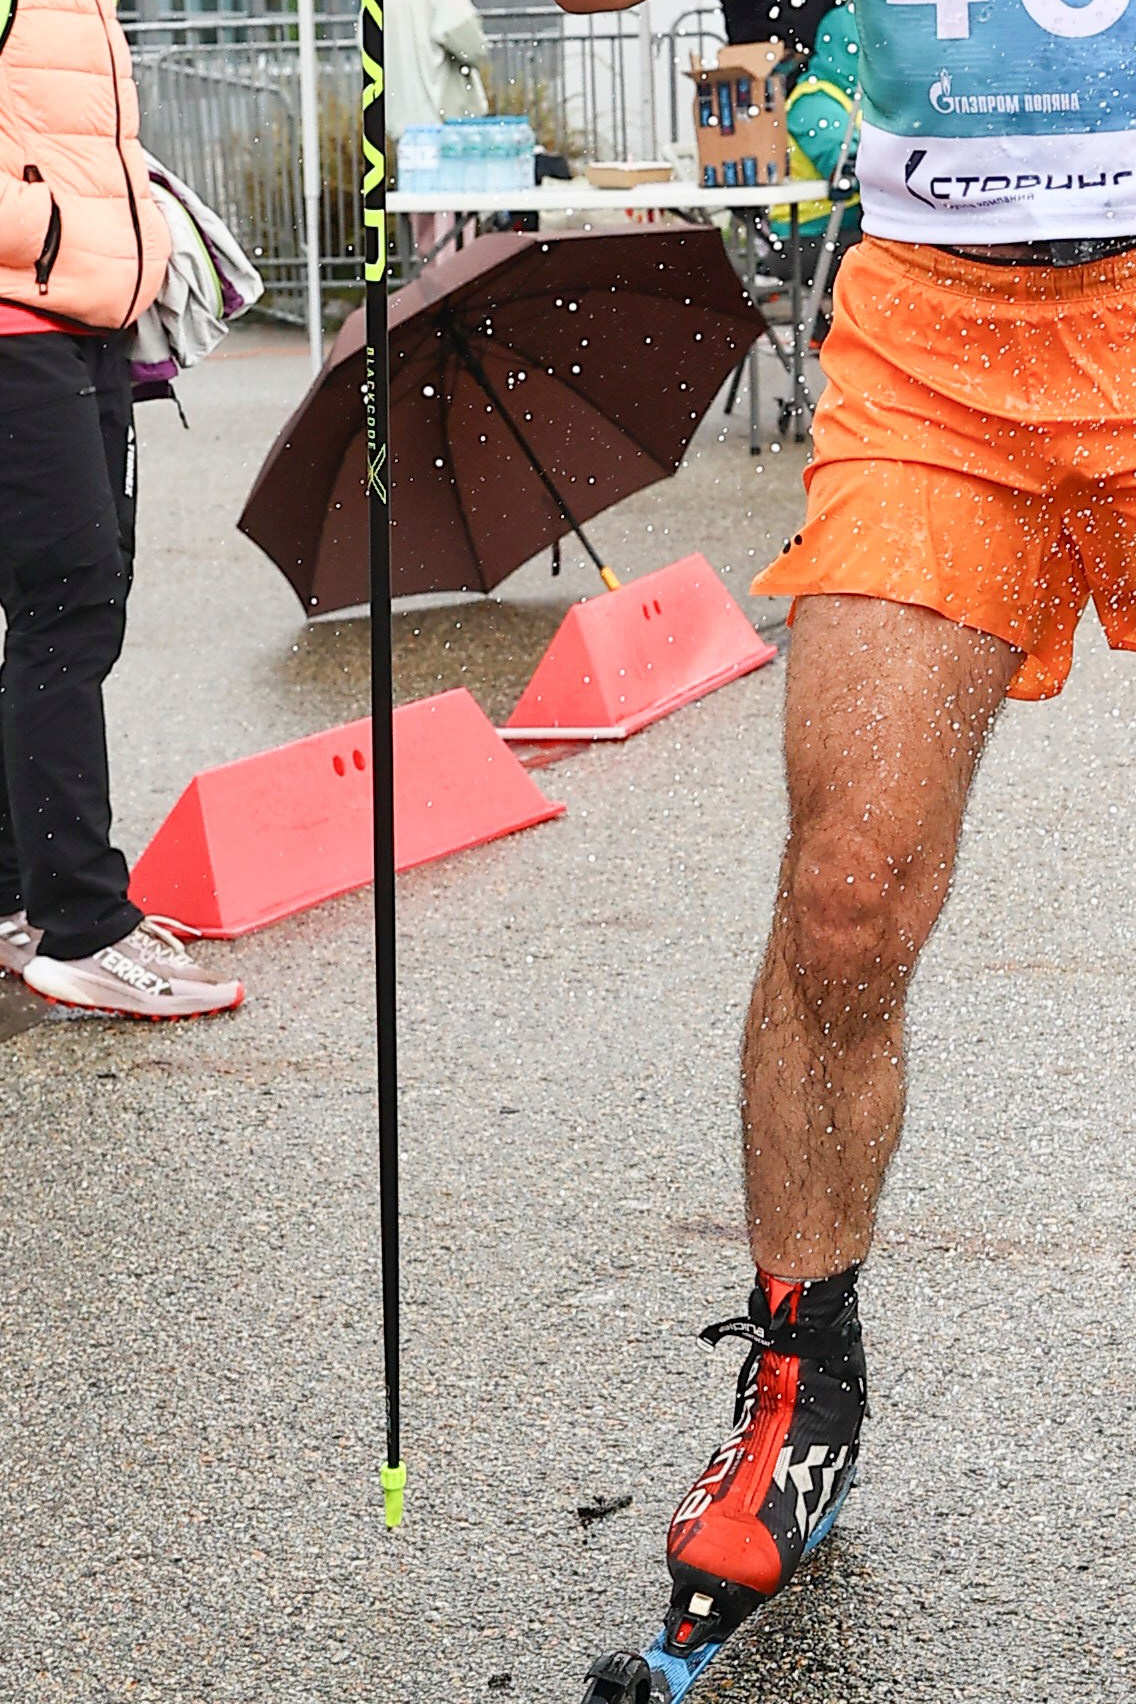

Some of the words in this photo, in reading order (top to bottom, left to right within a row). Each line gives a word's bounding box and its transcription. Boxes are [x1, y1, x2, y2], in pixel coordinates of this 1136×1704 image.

[954, 95, 1020, 114] ГАЗПРОМ
[1024, 92, 1080, 113] ПОЛЯНА
[366, 347, 377, 451] BLACKCODE
[92, 947, 169, 996] TERREX
